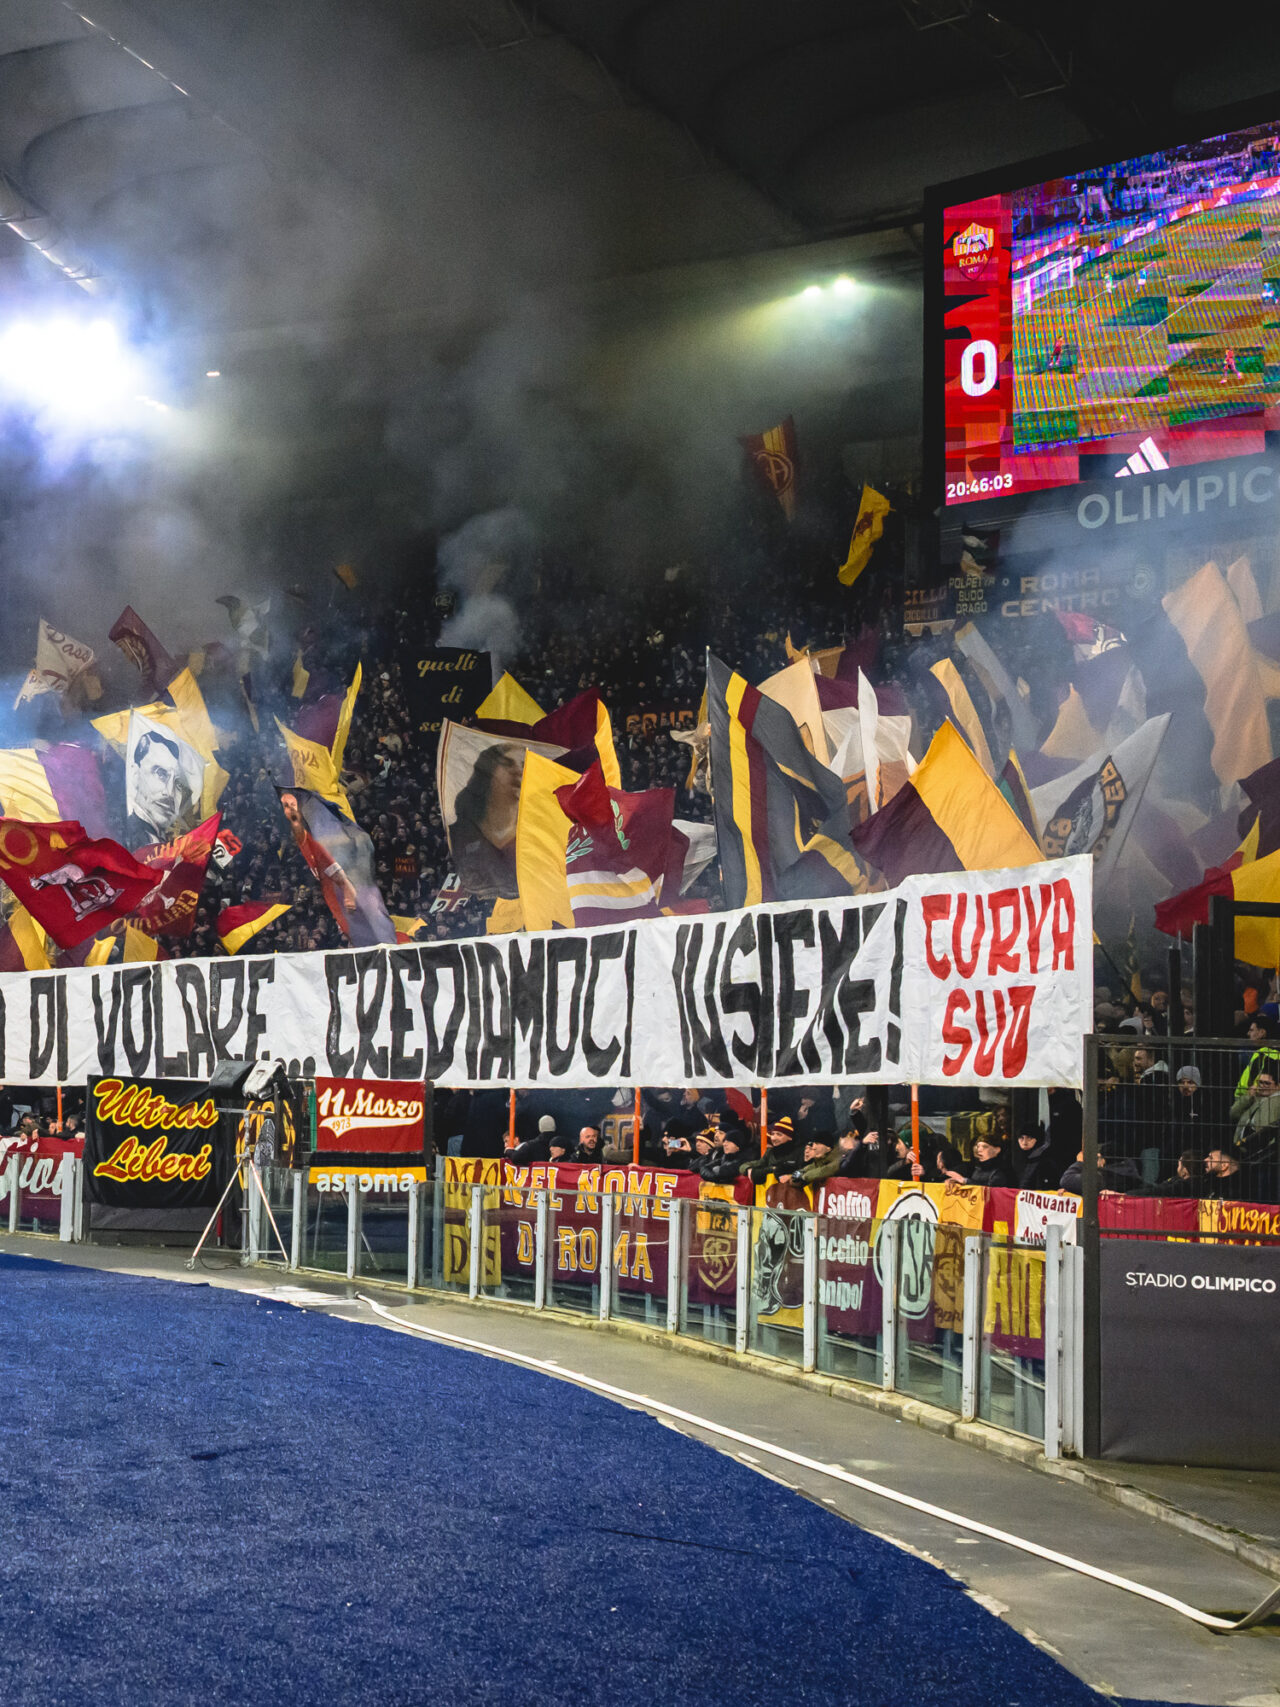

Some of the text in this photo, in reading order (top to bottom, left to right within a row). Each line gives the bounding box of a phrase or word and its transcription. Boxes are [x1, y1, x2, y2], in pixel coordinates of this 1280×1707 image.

[958, 253, 988, 267] ROMA
[961, 340, 998, 397] 0
[947, 474, 1014, 499] 20:46:03
[1077, 466, 1280, 529] OLIMPIC
[418, 653, 478, 678] quelli
[441, 685, 464, 704] di
[919, 876, 1076, 981] CURVA
[29, 974, 68, 1080] DI
[325, 928, 637, 1081] CREDIAMOCI
[671, 897, 908, 1080] INSIEME!
[941, 984, 1037, 1079] SUD
[93, 1078, 219, 1130] Ultras
[317, 1087, 423, 1118] 11 Marzo
[332, 1117, 352, 1131] 1973
[93, 1136, 213, 1182] Liberi
[316, 1172, 415, 1193] asroma
[503, 1162, 678, 1220] NEL NOME
[827, 1190, 871, 1222] solito
[1041, 1215, 1048, 1226] e
[557, 1225, 654, 1283] ROMA
[819, 1232, 869, 1266] ecchio
[1125, 1271, 1277, 1294] STADIO OLIMPICO
